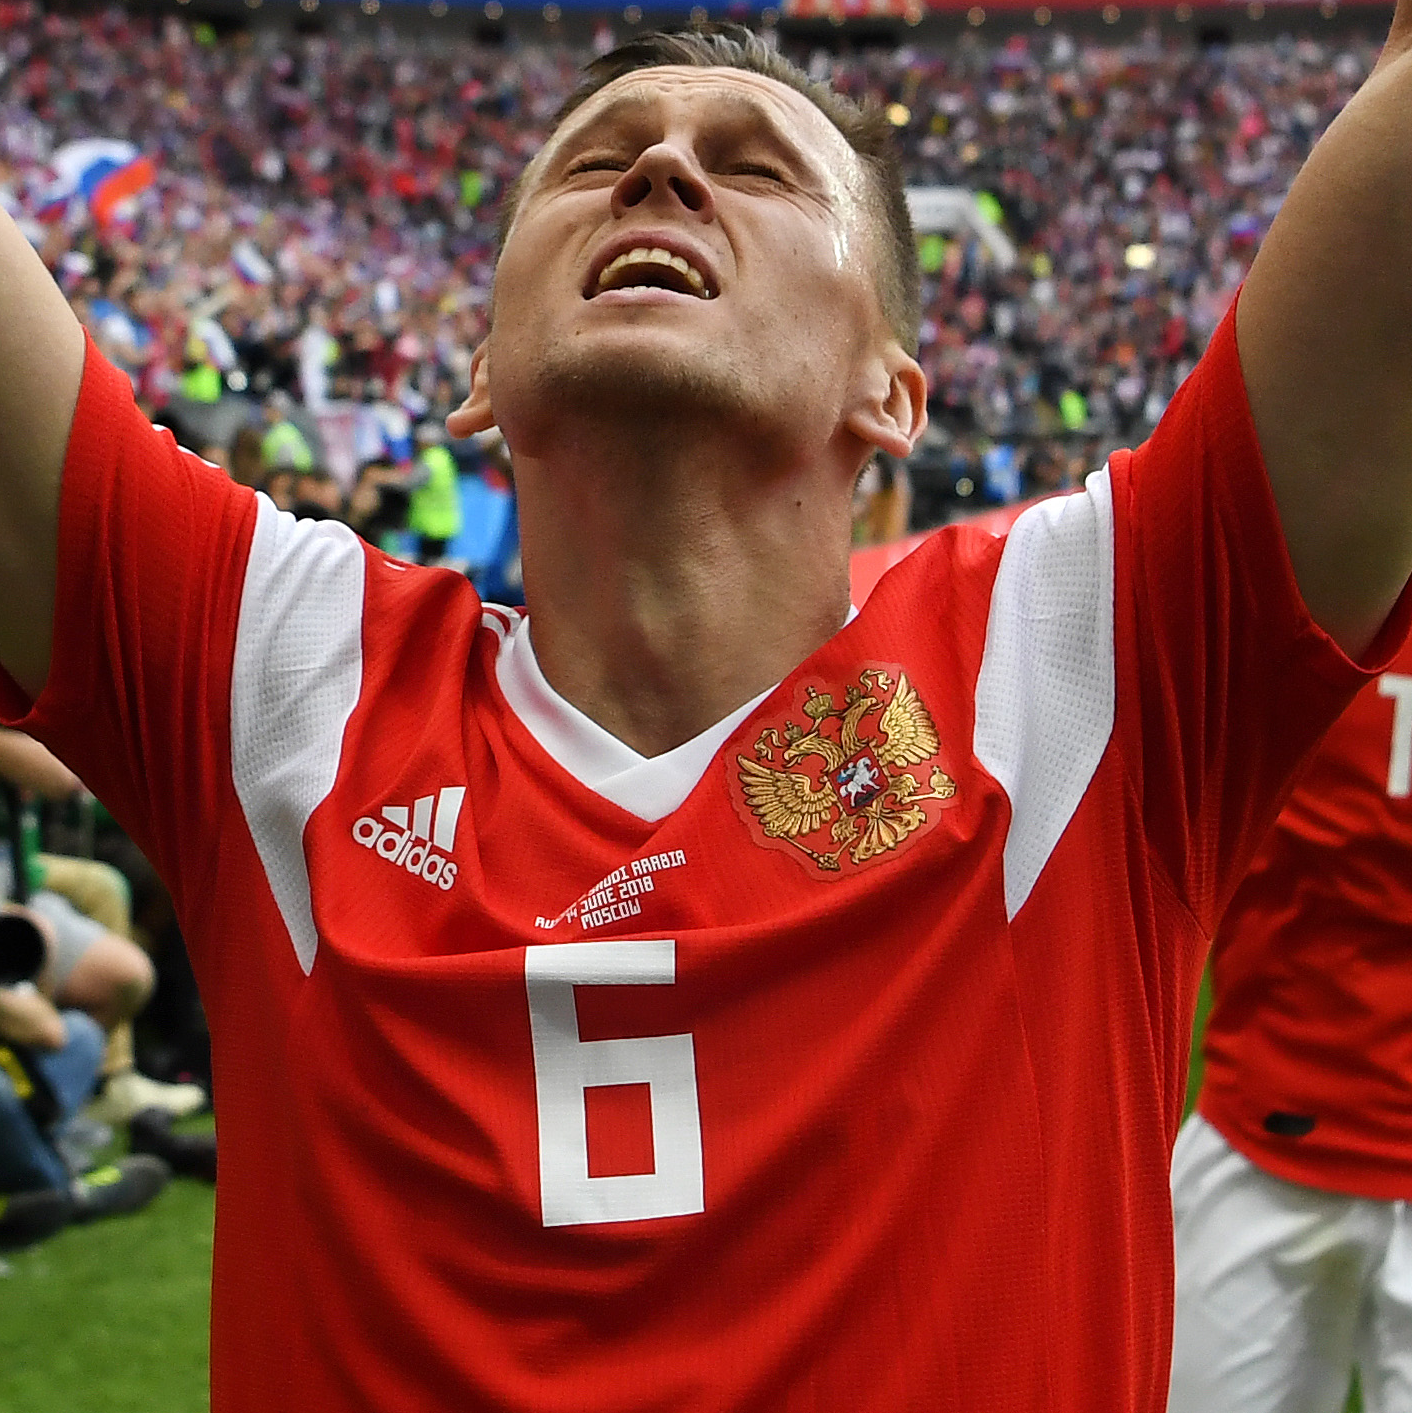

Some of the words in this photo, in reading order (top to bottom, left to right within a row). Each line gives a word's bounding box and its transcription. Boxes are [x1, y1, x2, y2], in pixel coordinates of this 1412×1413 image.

[352, 816, 458, 890] adidas
[631, 849, 686, 876] ARABIA
[580, 887, 617, 914] JUNE
[618, 876, 654, 899] 2018
[580, 898, 642, 930] MOSCOW
[525, 940, 705, 1227] 6
